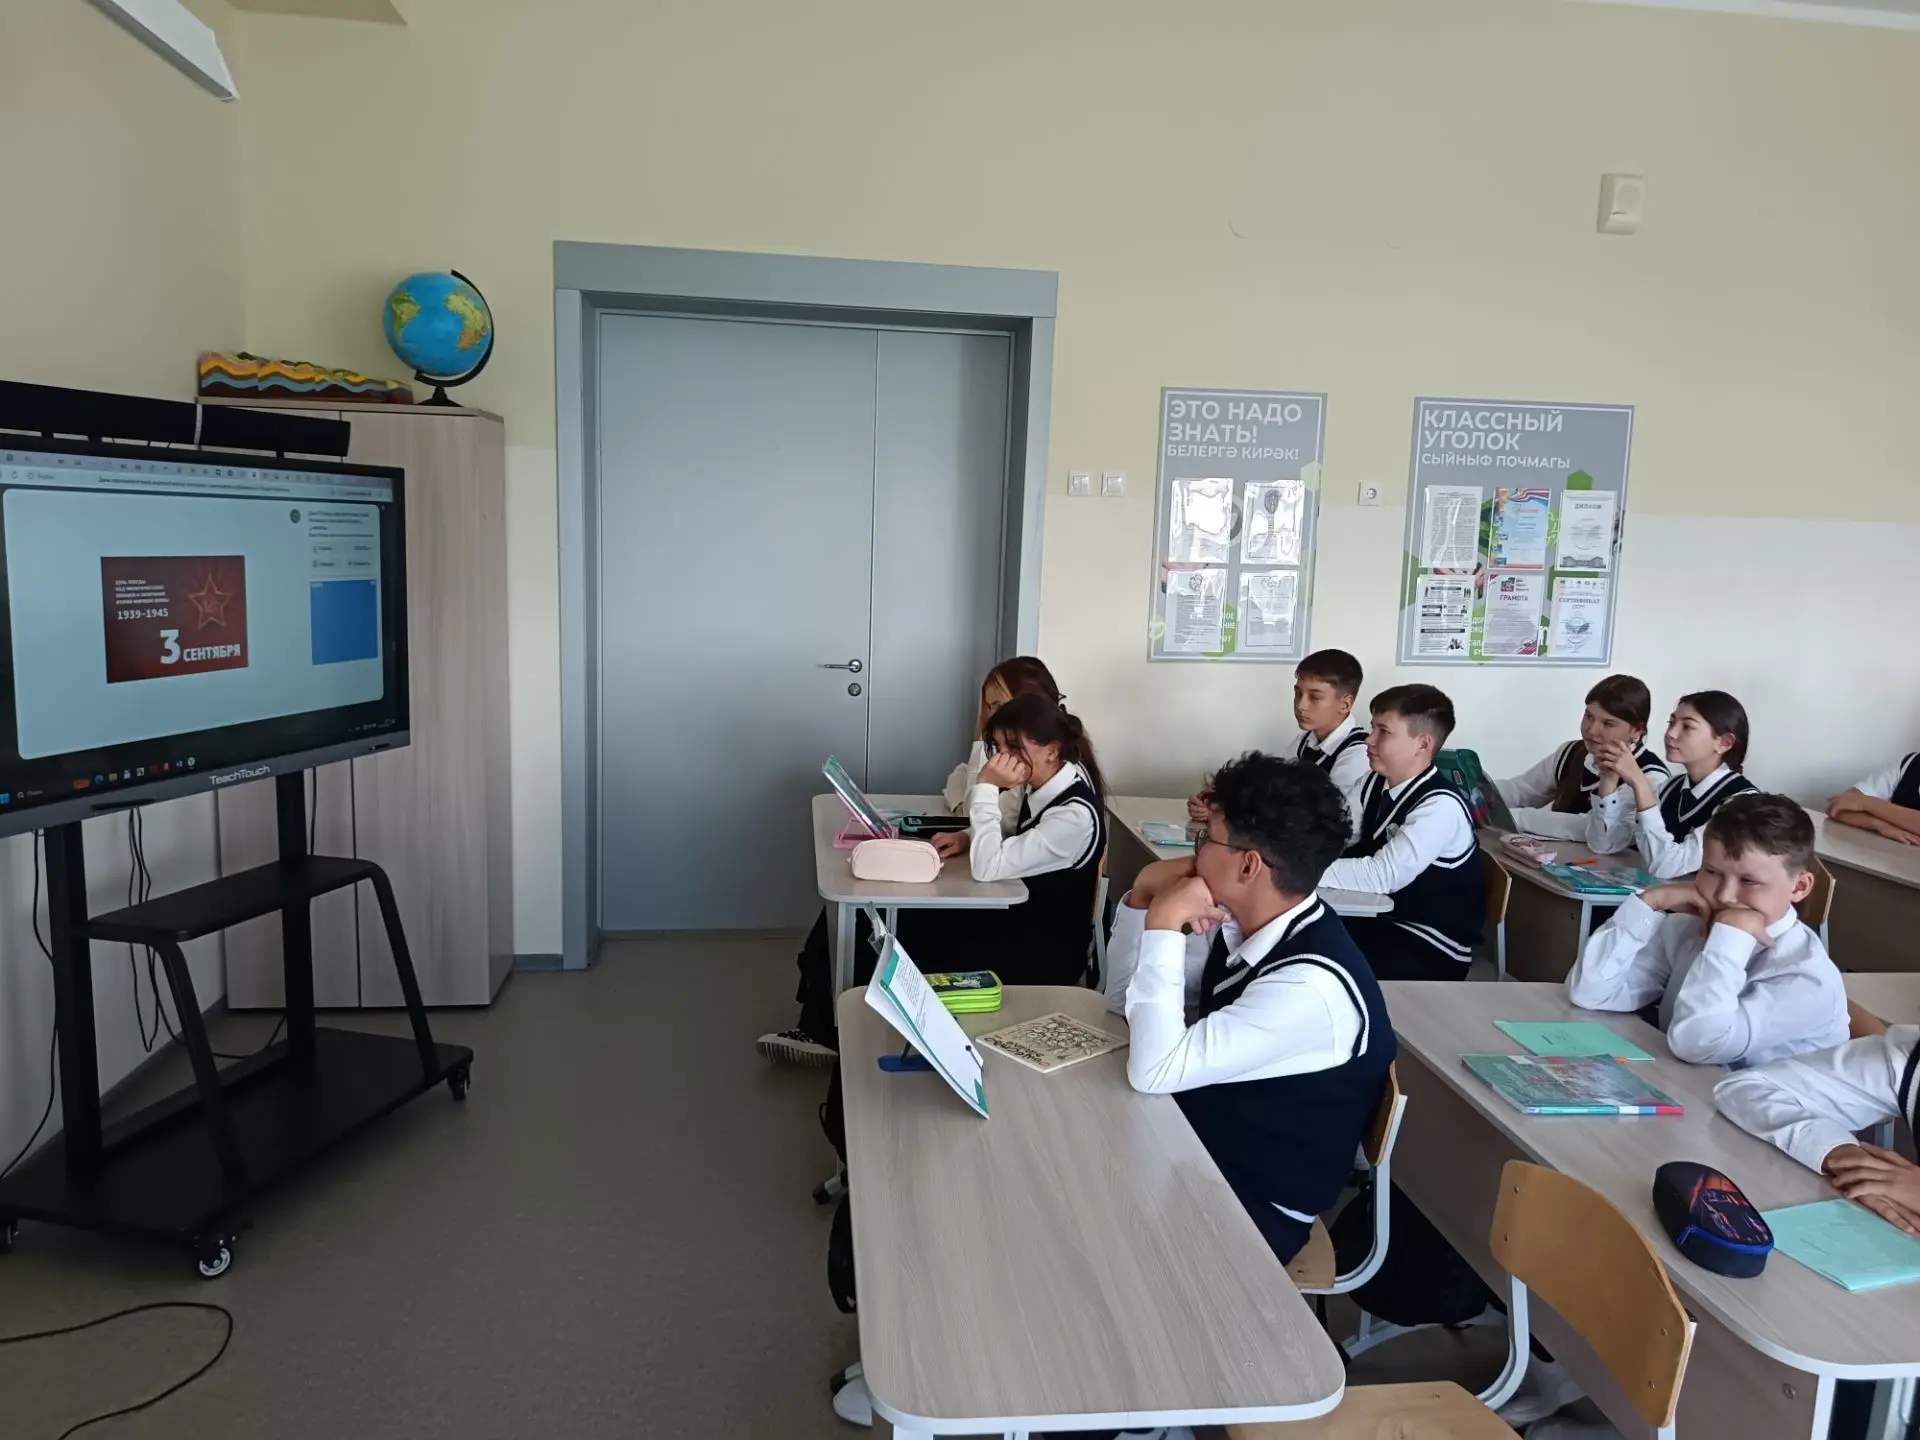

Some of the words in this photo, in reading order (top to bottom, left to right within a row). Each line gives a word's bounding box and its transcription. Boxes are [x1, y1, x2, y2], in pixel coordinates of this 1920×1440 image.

[1169, 399, 1221, 421] ЭТО
[1227, 401, 1303, 426] НАДО
[1423, 408, 1564, 433] КЛАССНЫЙ
[1167, 422, 1258, 444] ЗНАТЬ!
[1424, 430, 1521, 450] УГОЛОК
[1166, 443, 1238, 459] БЕЛЕРГӘ
[1241, 446, 1300, 461] КИРӘК!
[1421, 451, 1493, 467] СЫЙНЫФ
[1495, 455, 1571, 470] ПОЧМАГЫ
[1499, 594, 1529, 602] ГРАМОТА
[117, 608, 169, 620] 1939-1945
[159, 629, 181, 665] 3
[183, 644, 241, 661] СЕНТЯБРЯ
[208, 764, 270, 785] TeachTouch
